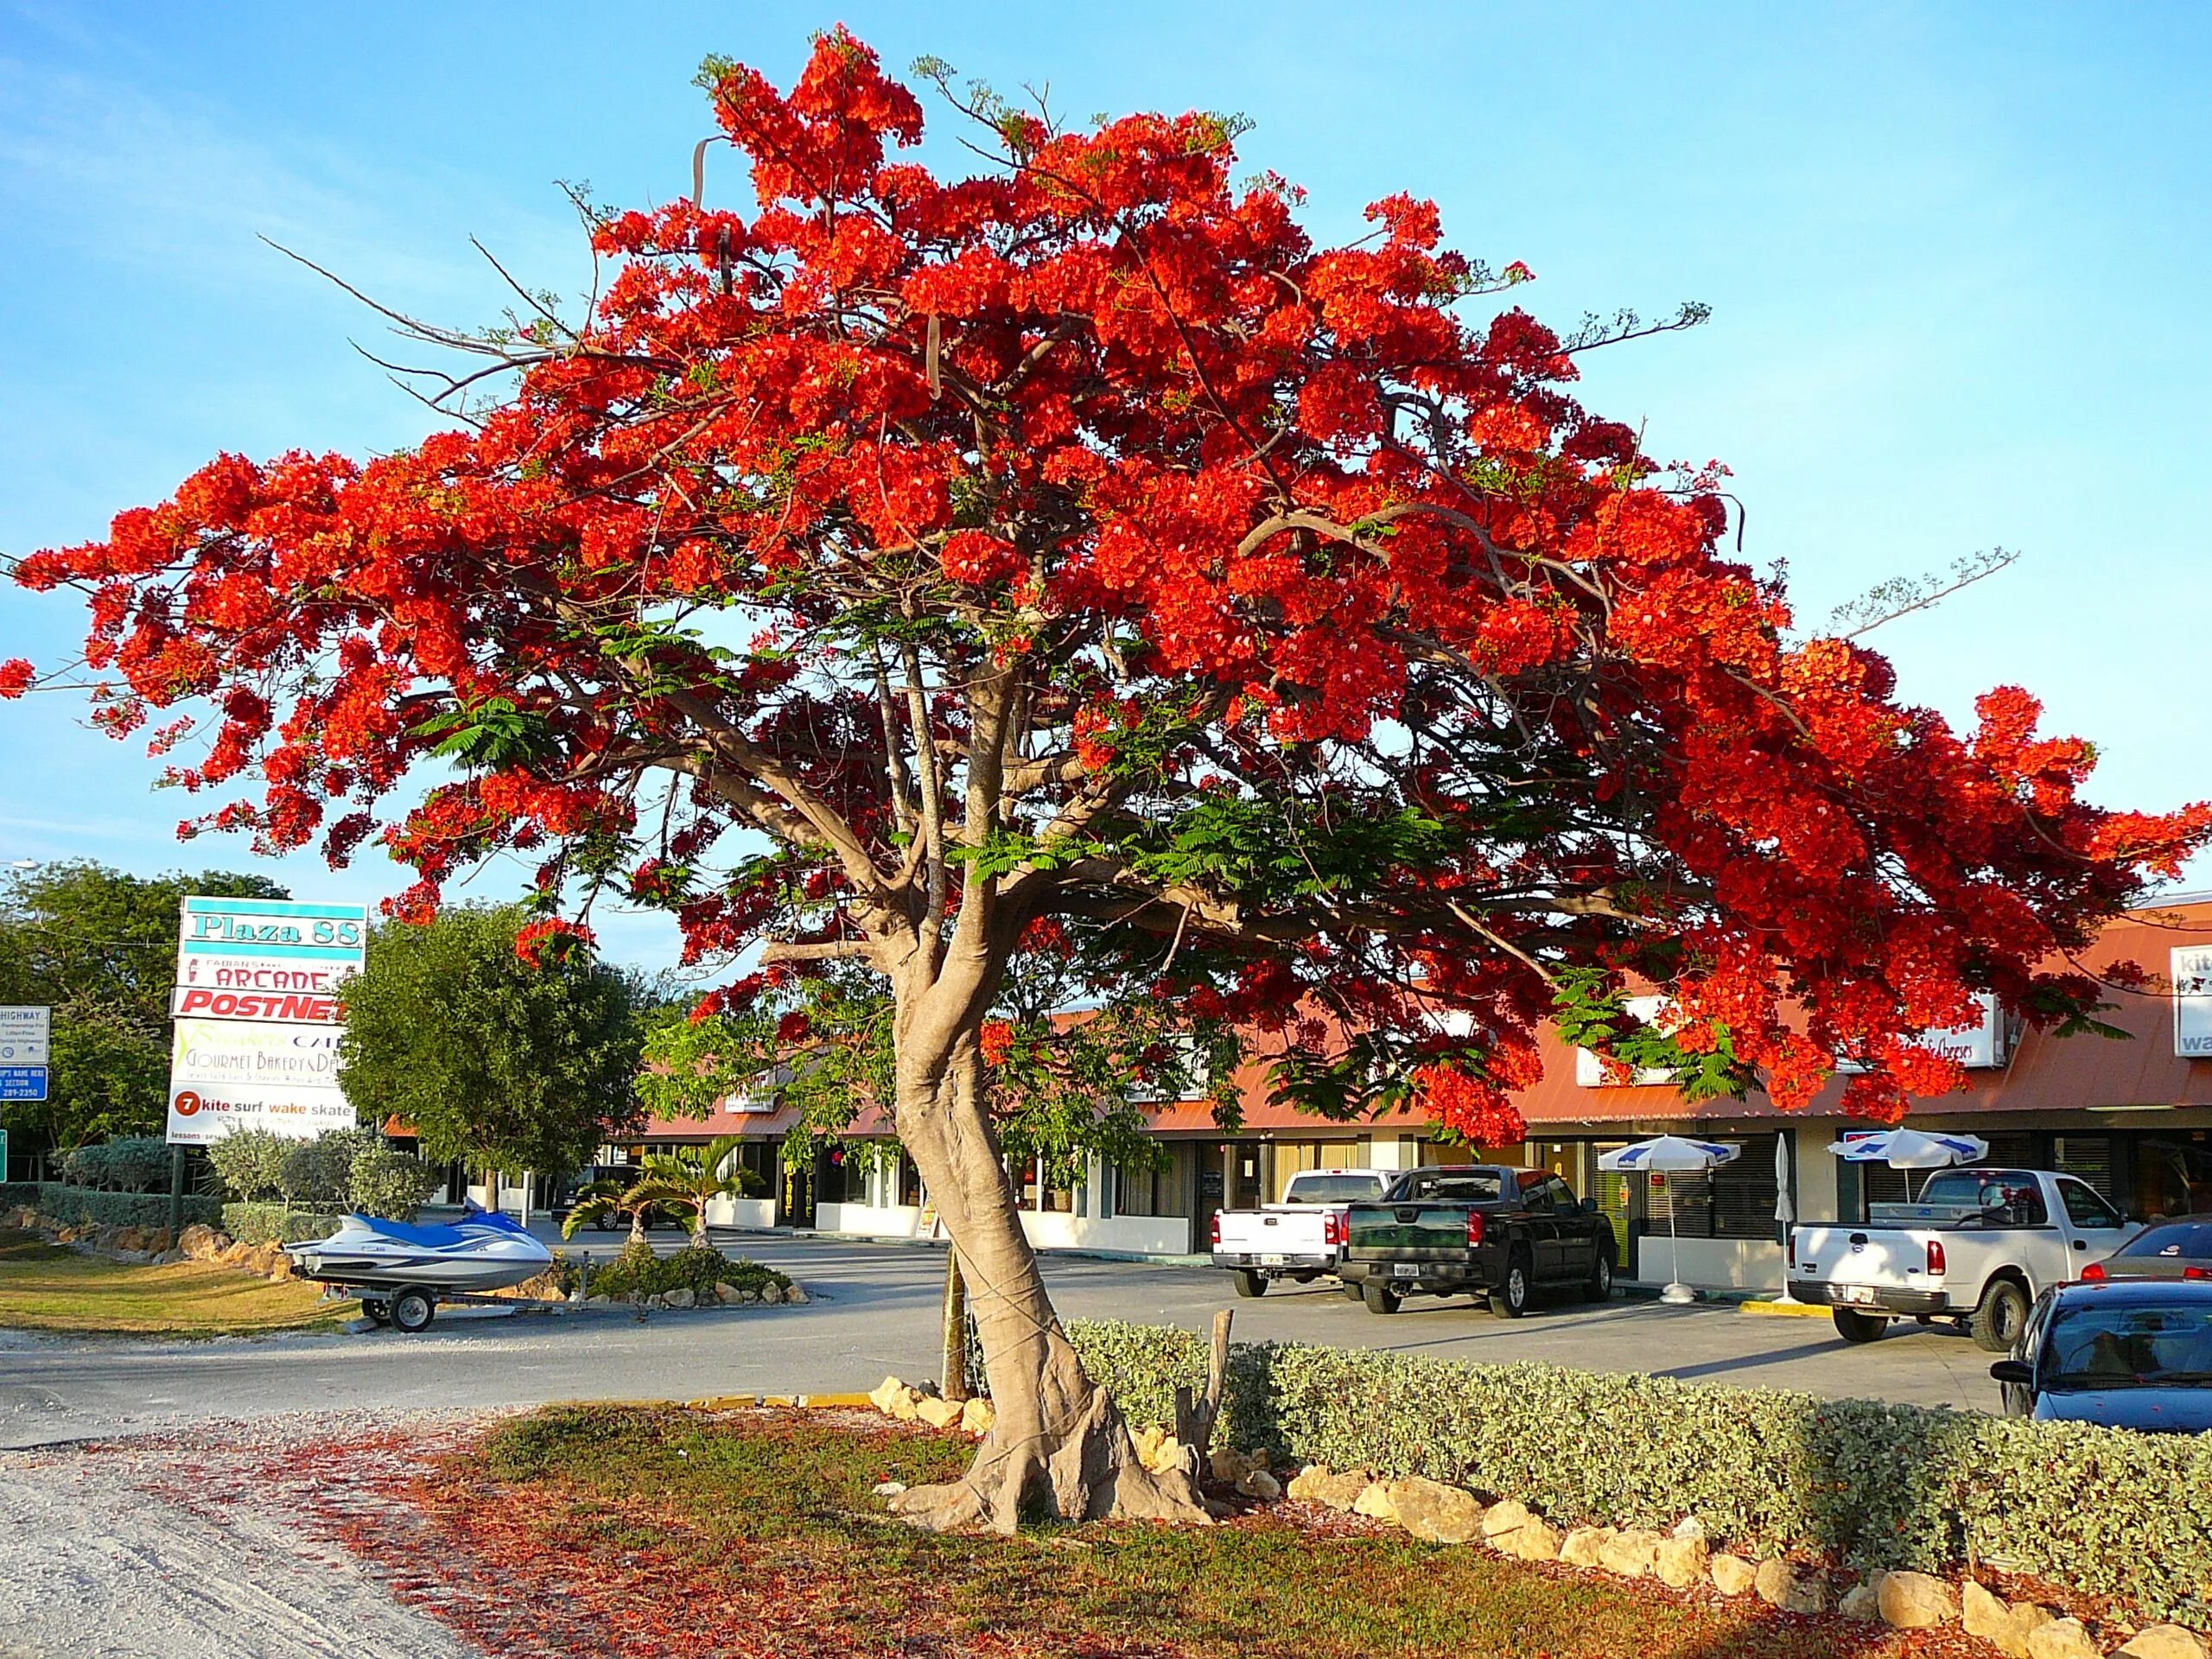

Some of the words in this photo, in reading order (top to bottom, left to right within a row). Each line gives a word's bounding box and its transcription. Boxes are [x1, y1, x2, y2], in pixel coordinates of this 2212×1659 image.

[191, 915, 302, 943] Plaza
[312, 921, 359, 945] 88
[2181, 955, 2212, 971] kit
[216, 969, 329, 990] ARCADE
[1, 1011, 41, 1020] HIGHWAY
[187, 1049, 251, 1070] GOURMET
[257, 1052, 304, 1071] BAKERY
[182, 1097, 194, 1110] 7
[201, 1099, 230, 1111] kite
[234, 1101, 263, 1112] surf
[269, 1103, 307, 1115] wake
[311, 1104, 351, 1116] skate
